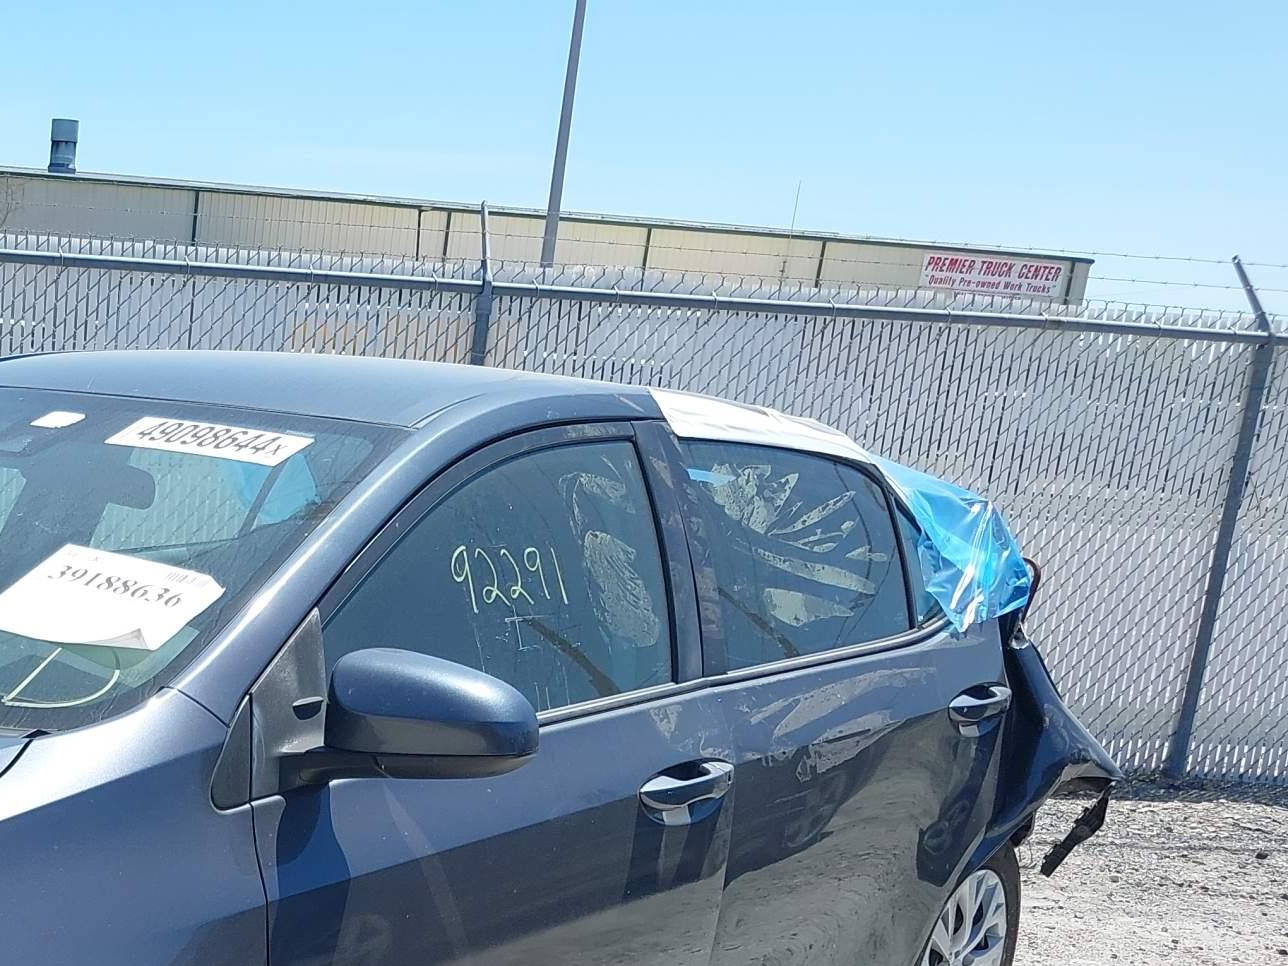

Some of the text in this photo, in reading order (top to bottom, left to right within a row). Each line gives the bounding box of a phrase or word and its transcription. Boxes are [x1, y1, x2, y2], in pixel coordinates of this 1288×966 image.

[925, 256, 1062, 281] PREMIER TRUCK CENTER
[958, 277, 1001, 290] Pre-owned
[1003, 281, 1022, 291] Work
[47, 563, 185, 609] 39188636
[451, 545, 569, 613] 92291
